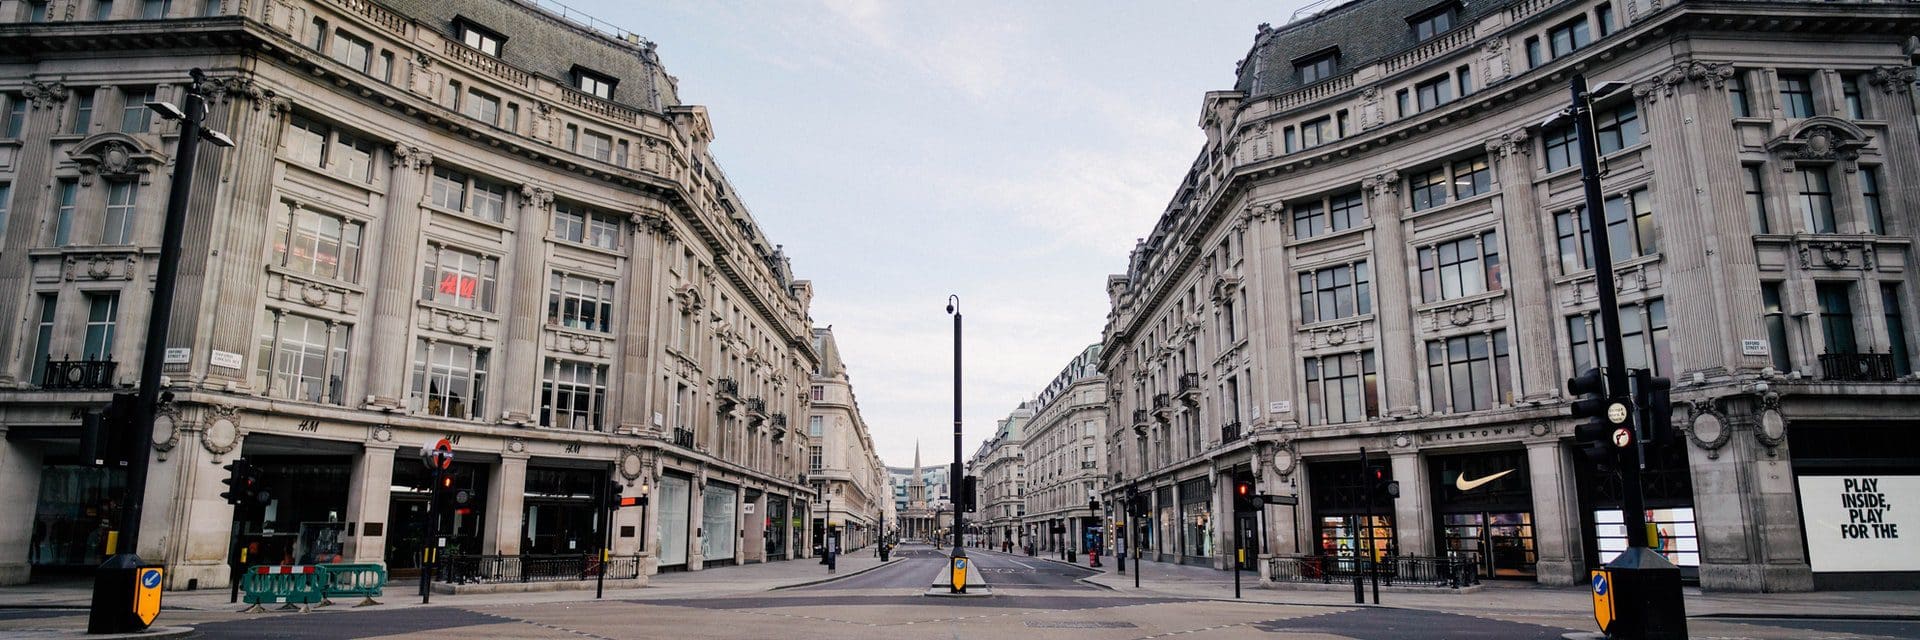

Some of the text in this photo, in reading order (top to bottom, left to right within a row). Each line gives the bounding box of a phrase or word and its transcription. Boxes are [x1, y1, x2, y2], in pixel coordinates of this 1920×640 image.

[440, 272, 476, 298] H&M
[298, 420, 320, 432] H&M
[1424, 427, 1515, 441] NIKETOWN
[565, 443, 581, 454] H&M
[1843, 478, 1878, 493] PLAY
[1841, 493, 1891, 511] INSIDE,
[1849, 508, 1883, 523] PLAY
[1841, 524, 1899, 539] FOR THE
